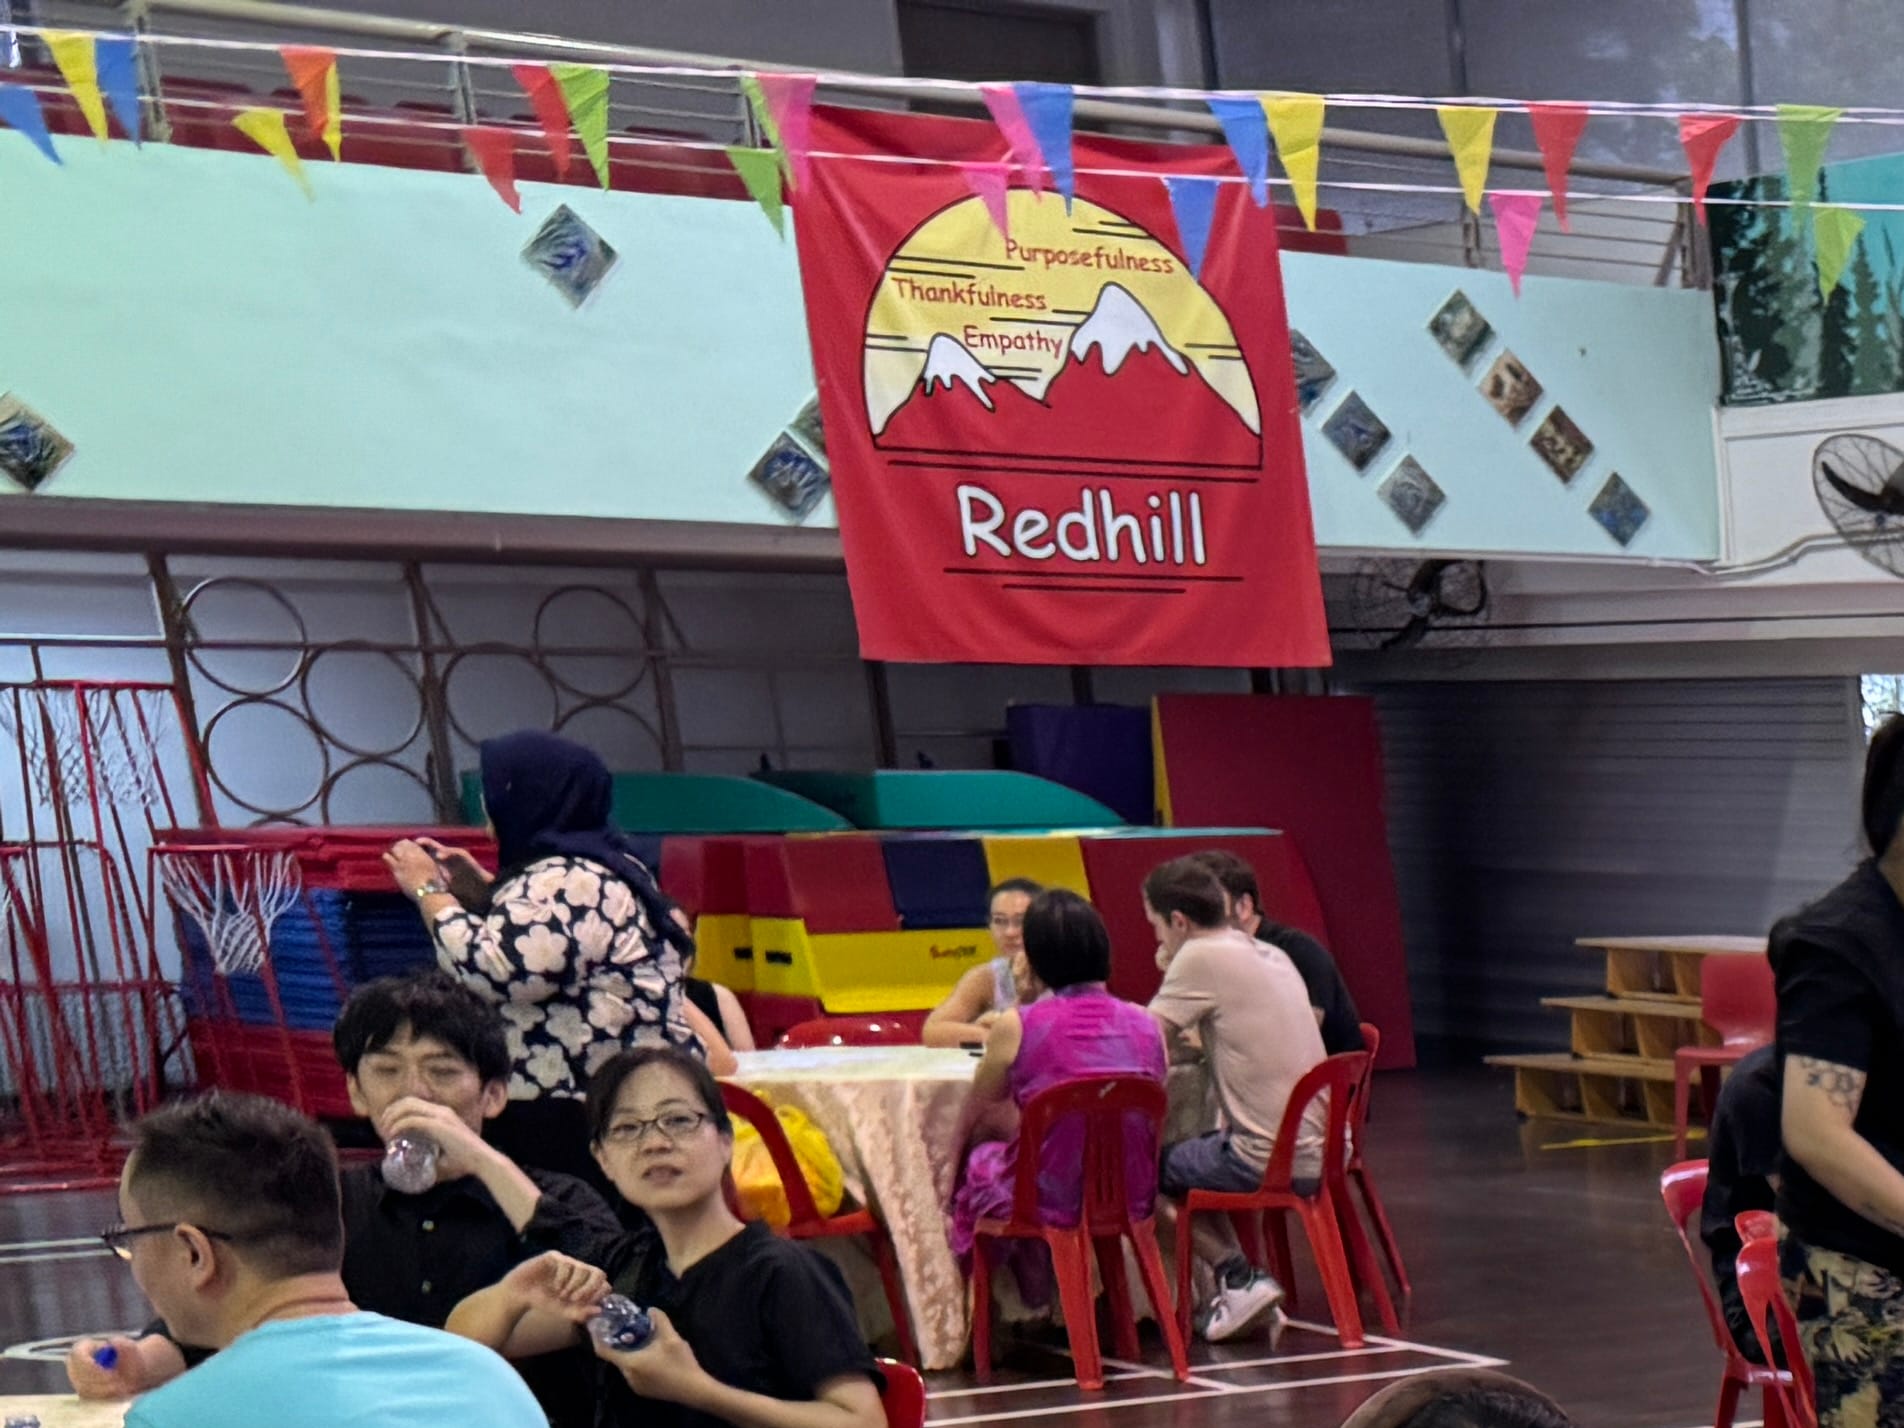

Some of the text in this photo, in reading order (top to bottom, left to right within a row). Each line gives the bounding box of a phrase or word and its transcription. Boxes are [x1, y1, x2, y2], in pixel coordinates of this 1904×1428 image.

[1005, 237, 1174, 273] Purposefulness
[891, 277, 1047, 310] Thankfulness
[963, 325, 1062, 360] Empathy
[957, 484, 1206, 566] Redhill
